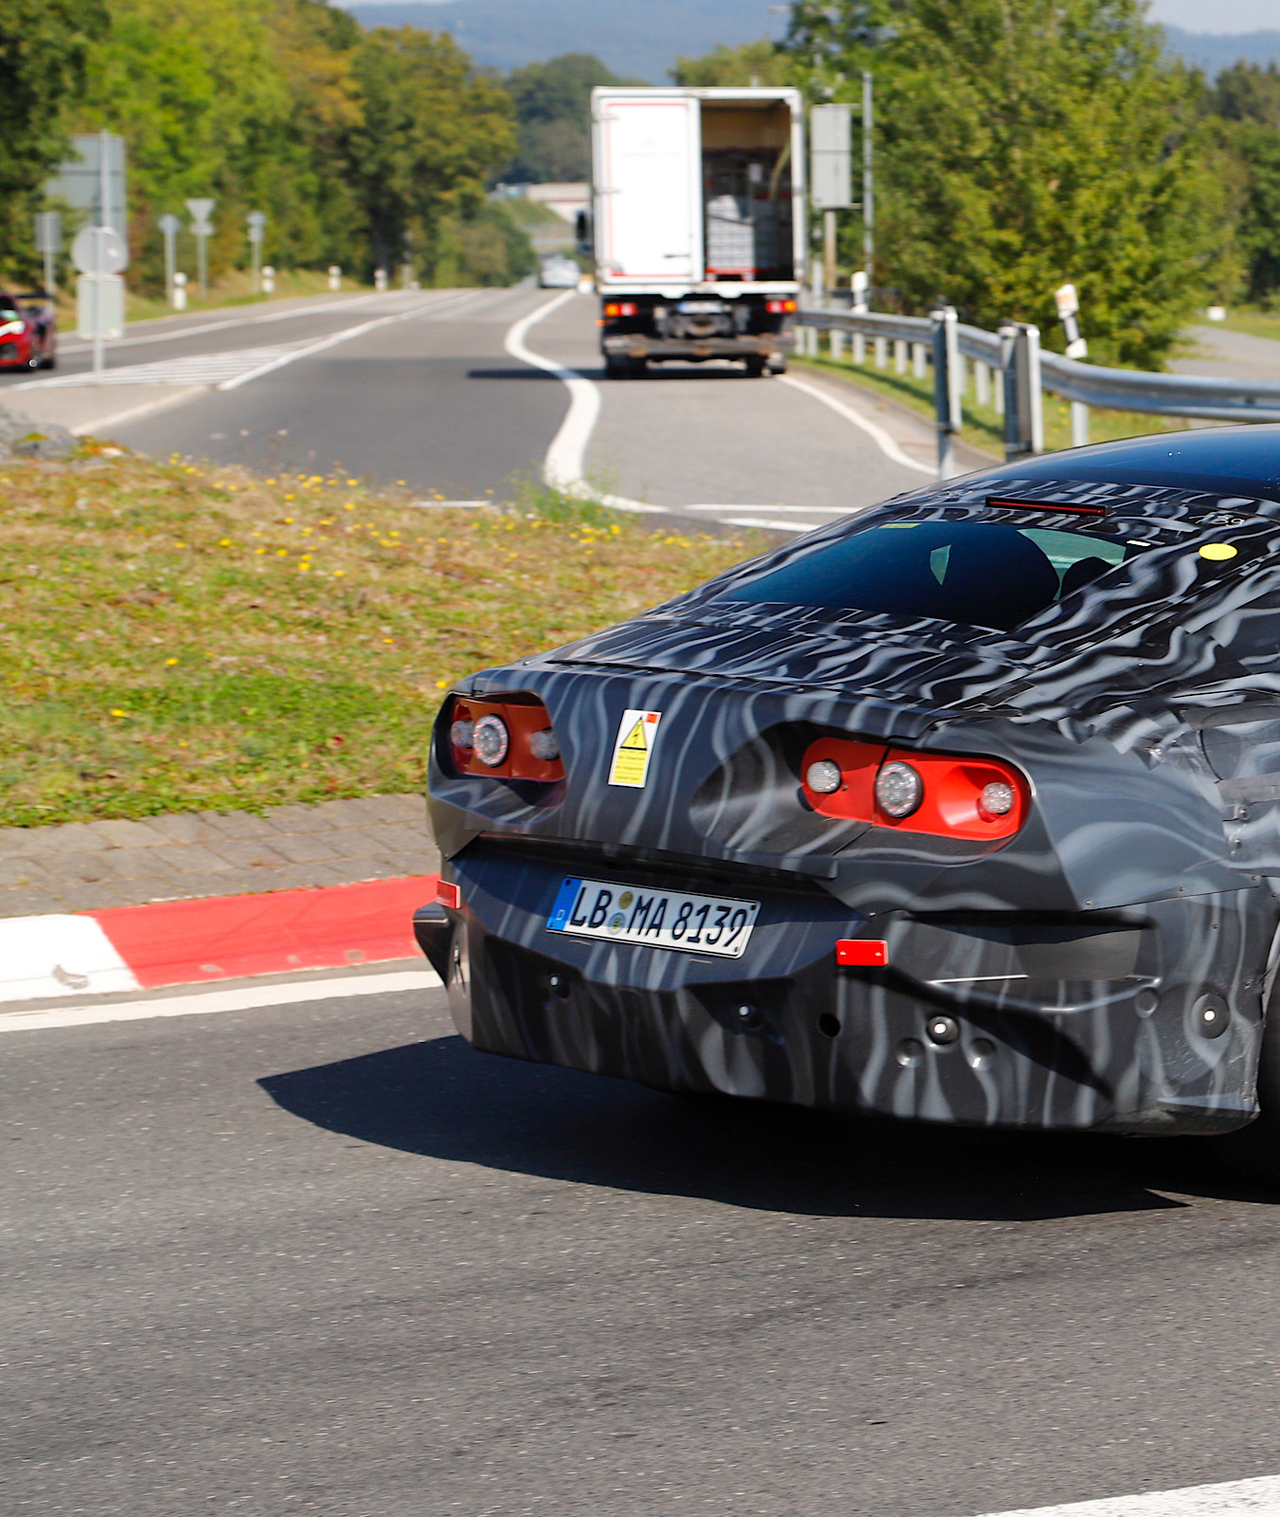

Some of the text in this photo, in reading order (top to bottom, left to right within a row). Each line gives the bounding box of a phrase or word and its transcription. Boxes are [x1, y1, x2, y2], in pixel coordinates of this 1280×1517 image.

[556, 909, 566, 921] D
[569, 886, 748, 947] LB MA 8139
